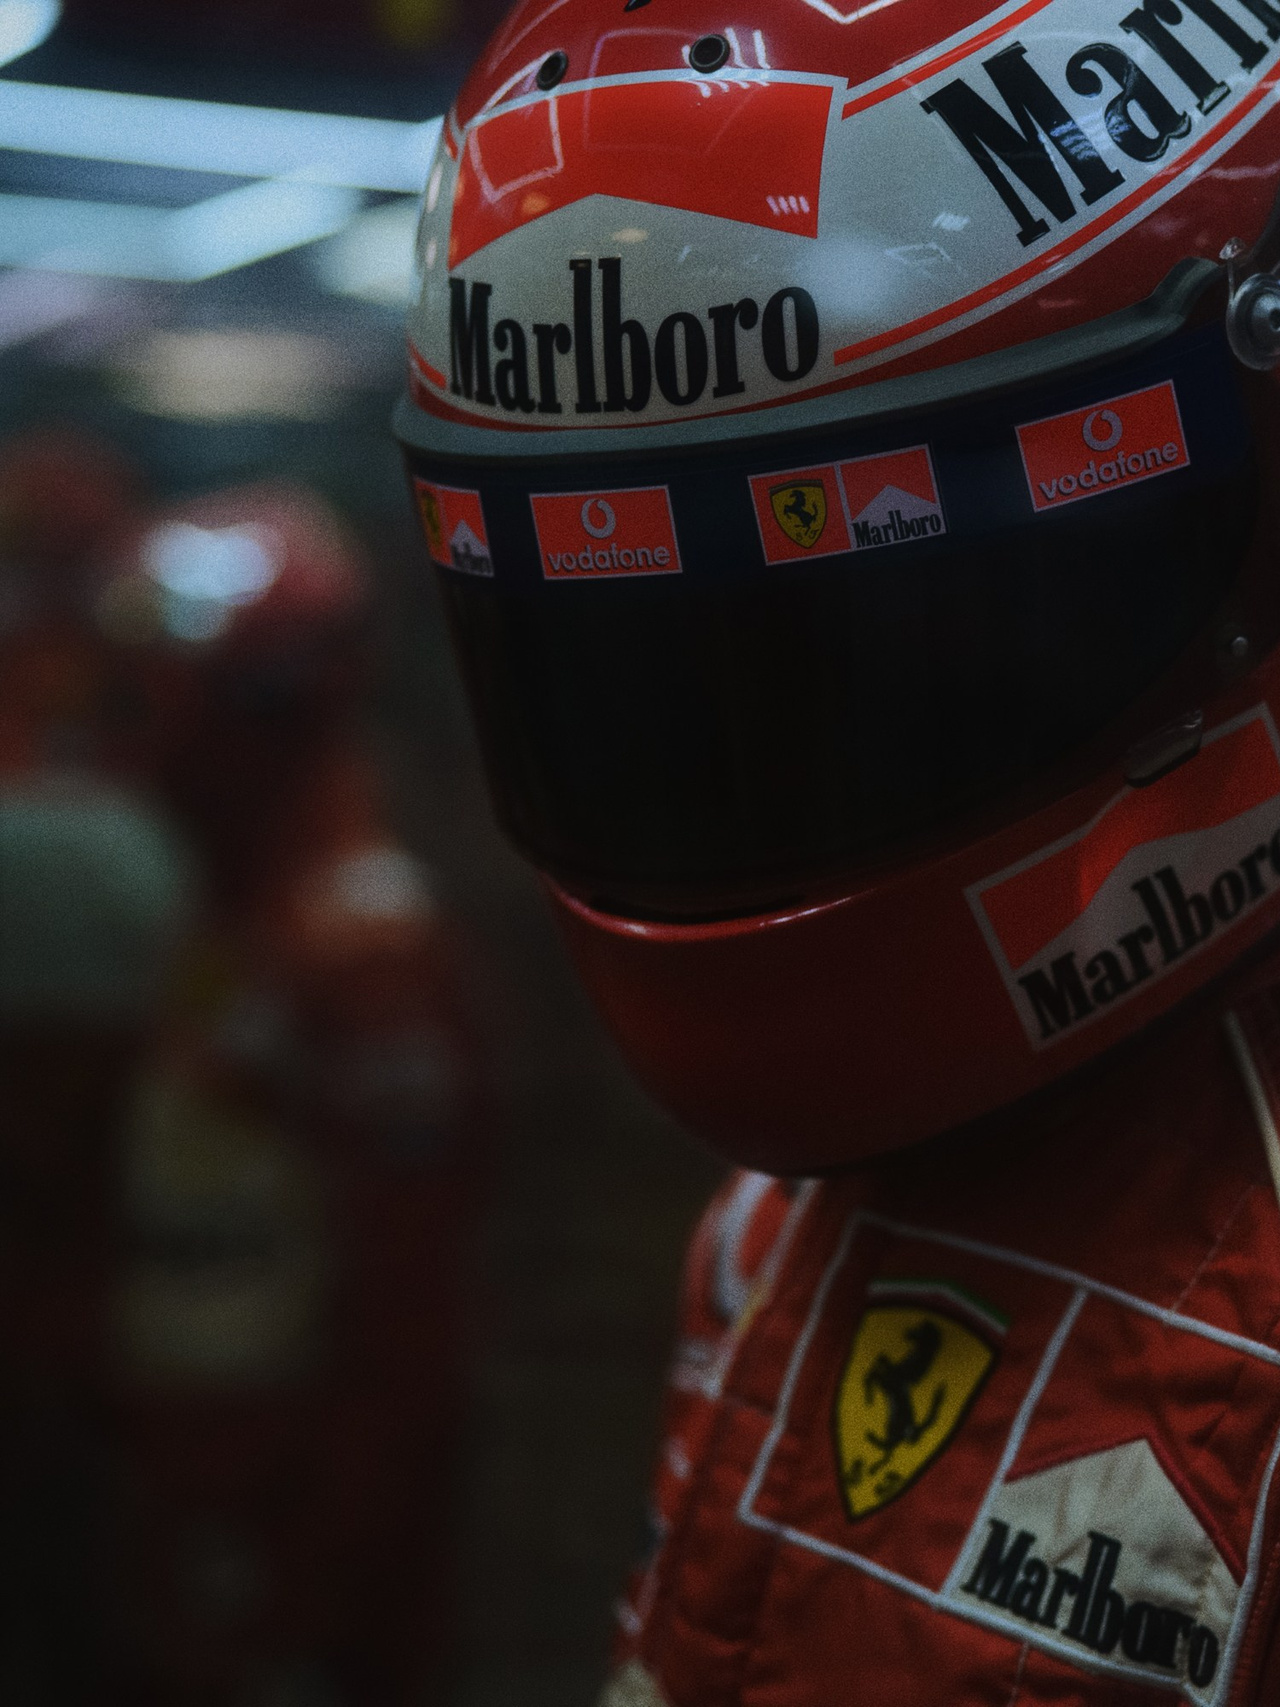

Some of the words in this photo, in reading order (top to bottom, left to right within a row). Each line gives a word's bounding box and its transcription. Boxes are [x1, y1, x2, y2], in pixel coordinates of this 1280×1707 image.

[449, 256, 820, 415] Marlboro
[1039, 441, 1179, 500] vodafone
[547, 542, 671, 572] vodafone
[852, 509, 942, 549] Marlboro
[960, 1517, 1219, 1689] Marlboro
